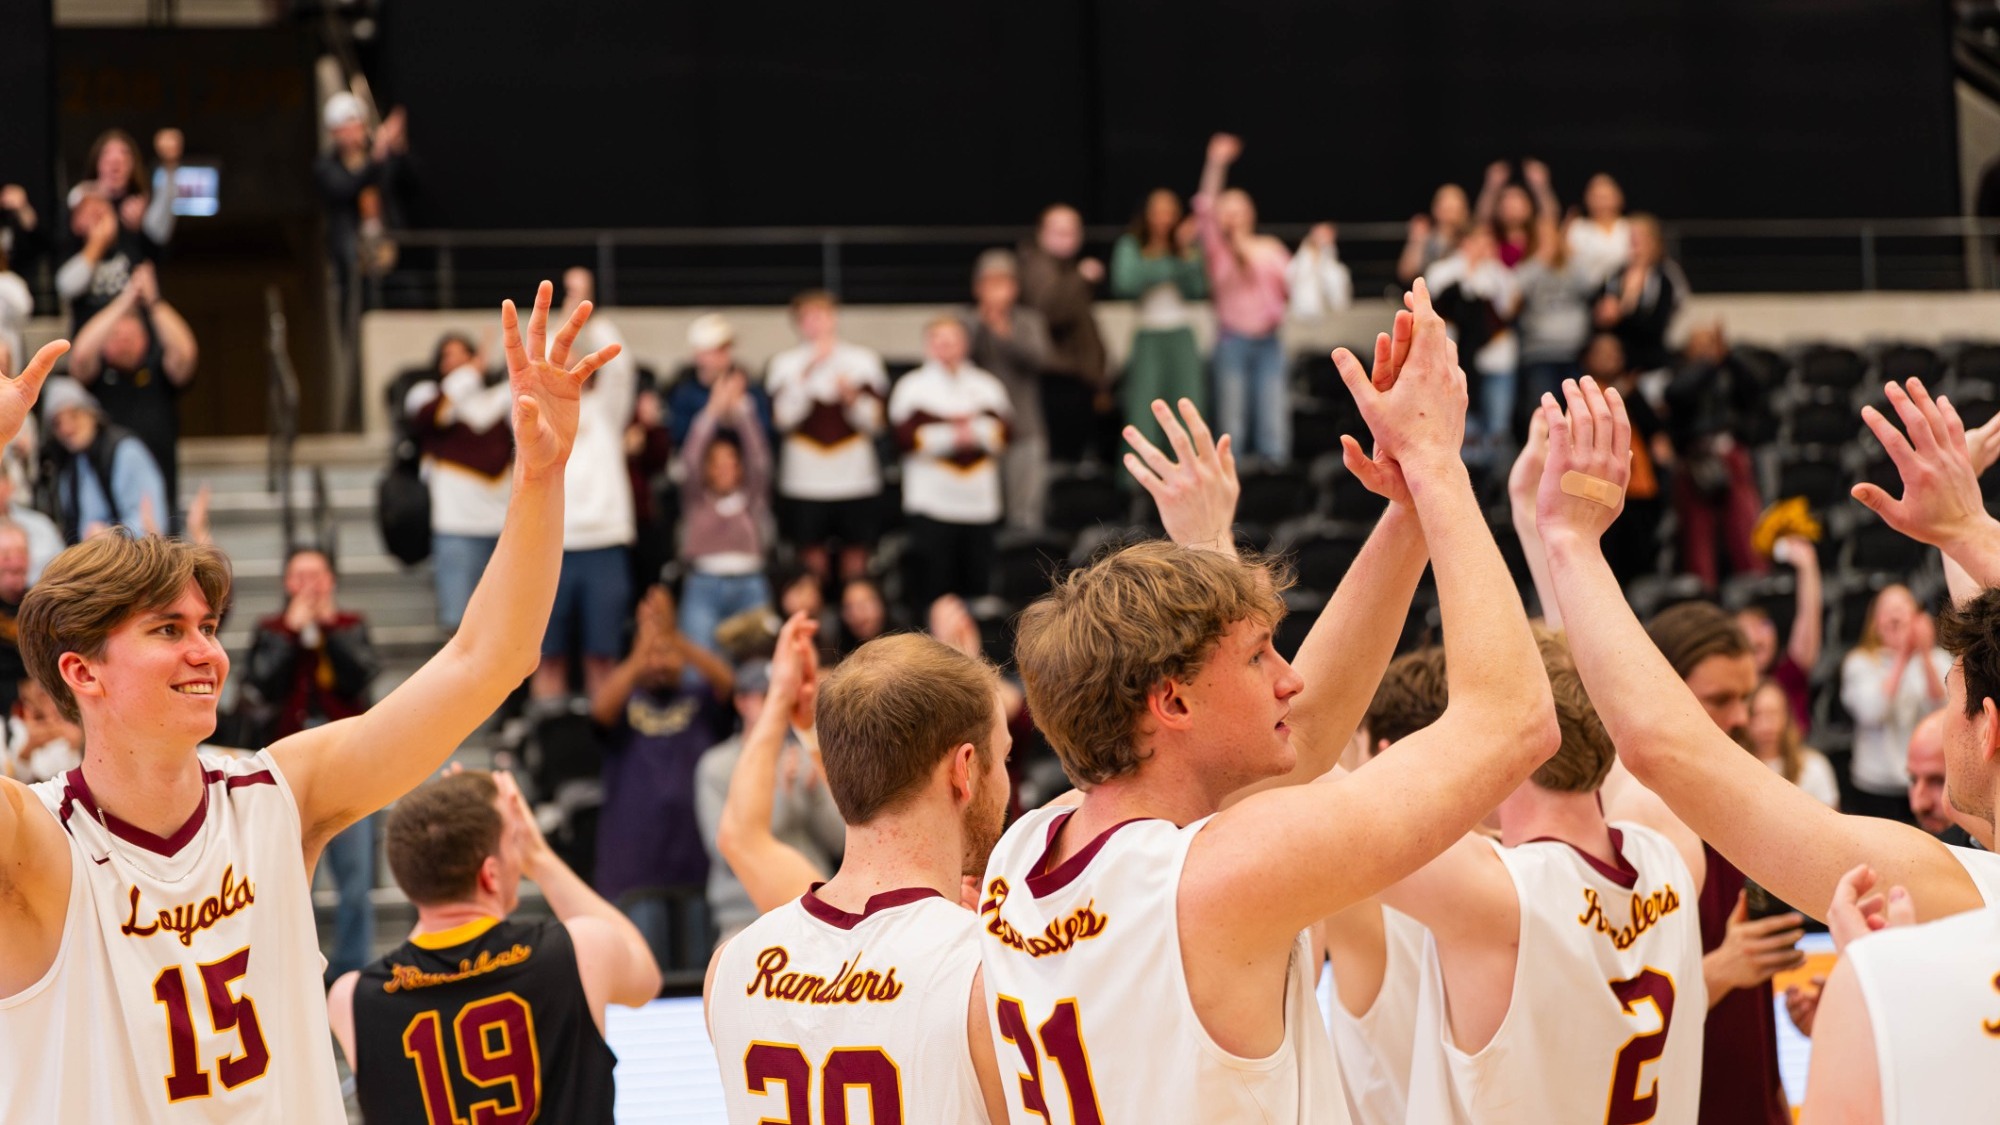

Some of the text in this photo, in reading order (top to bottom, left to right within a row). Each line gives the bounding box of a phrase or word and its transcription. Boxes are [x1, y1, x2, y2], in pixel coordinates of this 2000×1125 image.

[121, 863, 255, 947] Loyola
[1578, 883, 1680, 951] Rlers
[152, 944, 271, 1103] 15
[402, 991, 542, 1125] 19
[997, 993, 1105, 1125] 31
[1604, 965, 1677, 1125] 2
